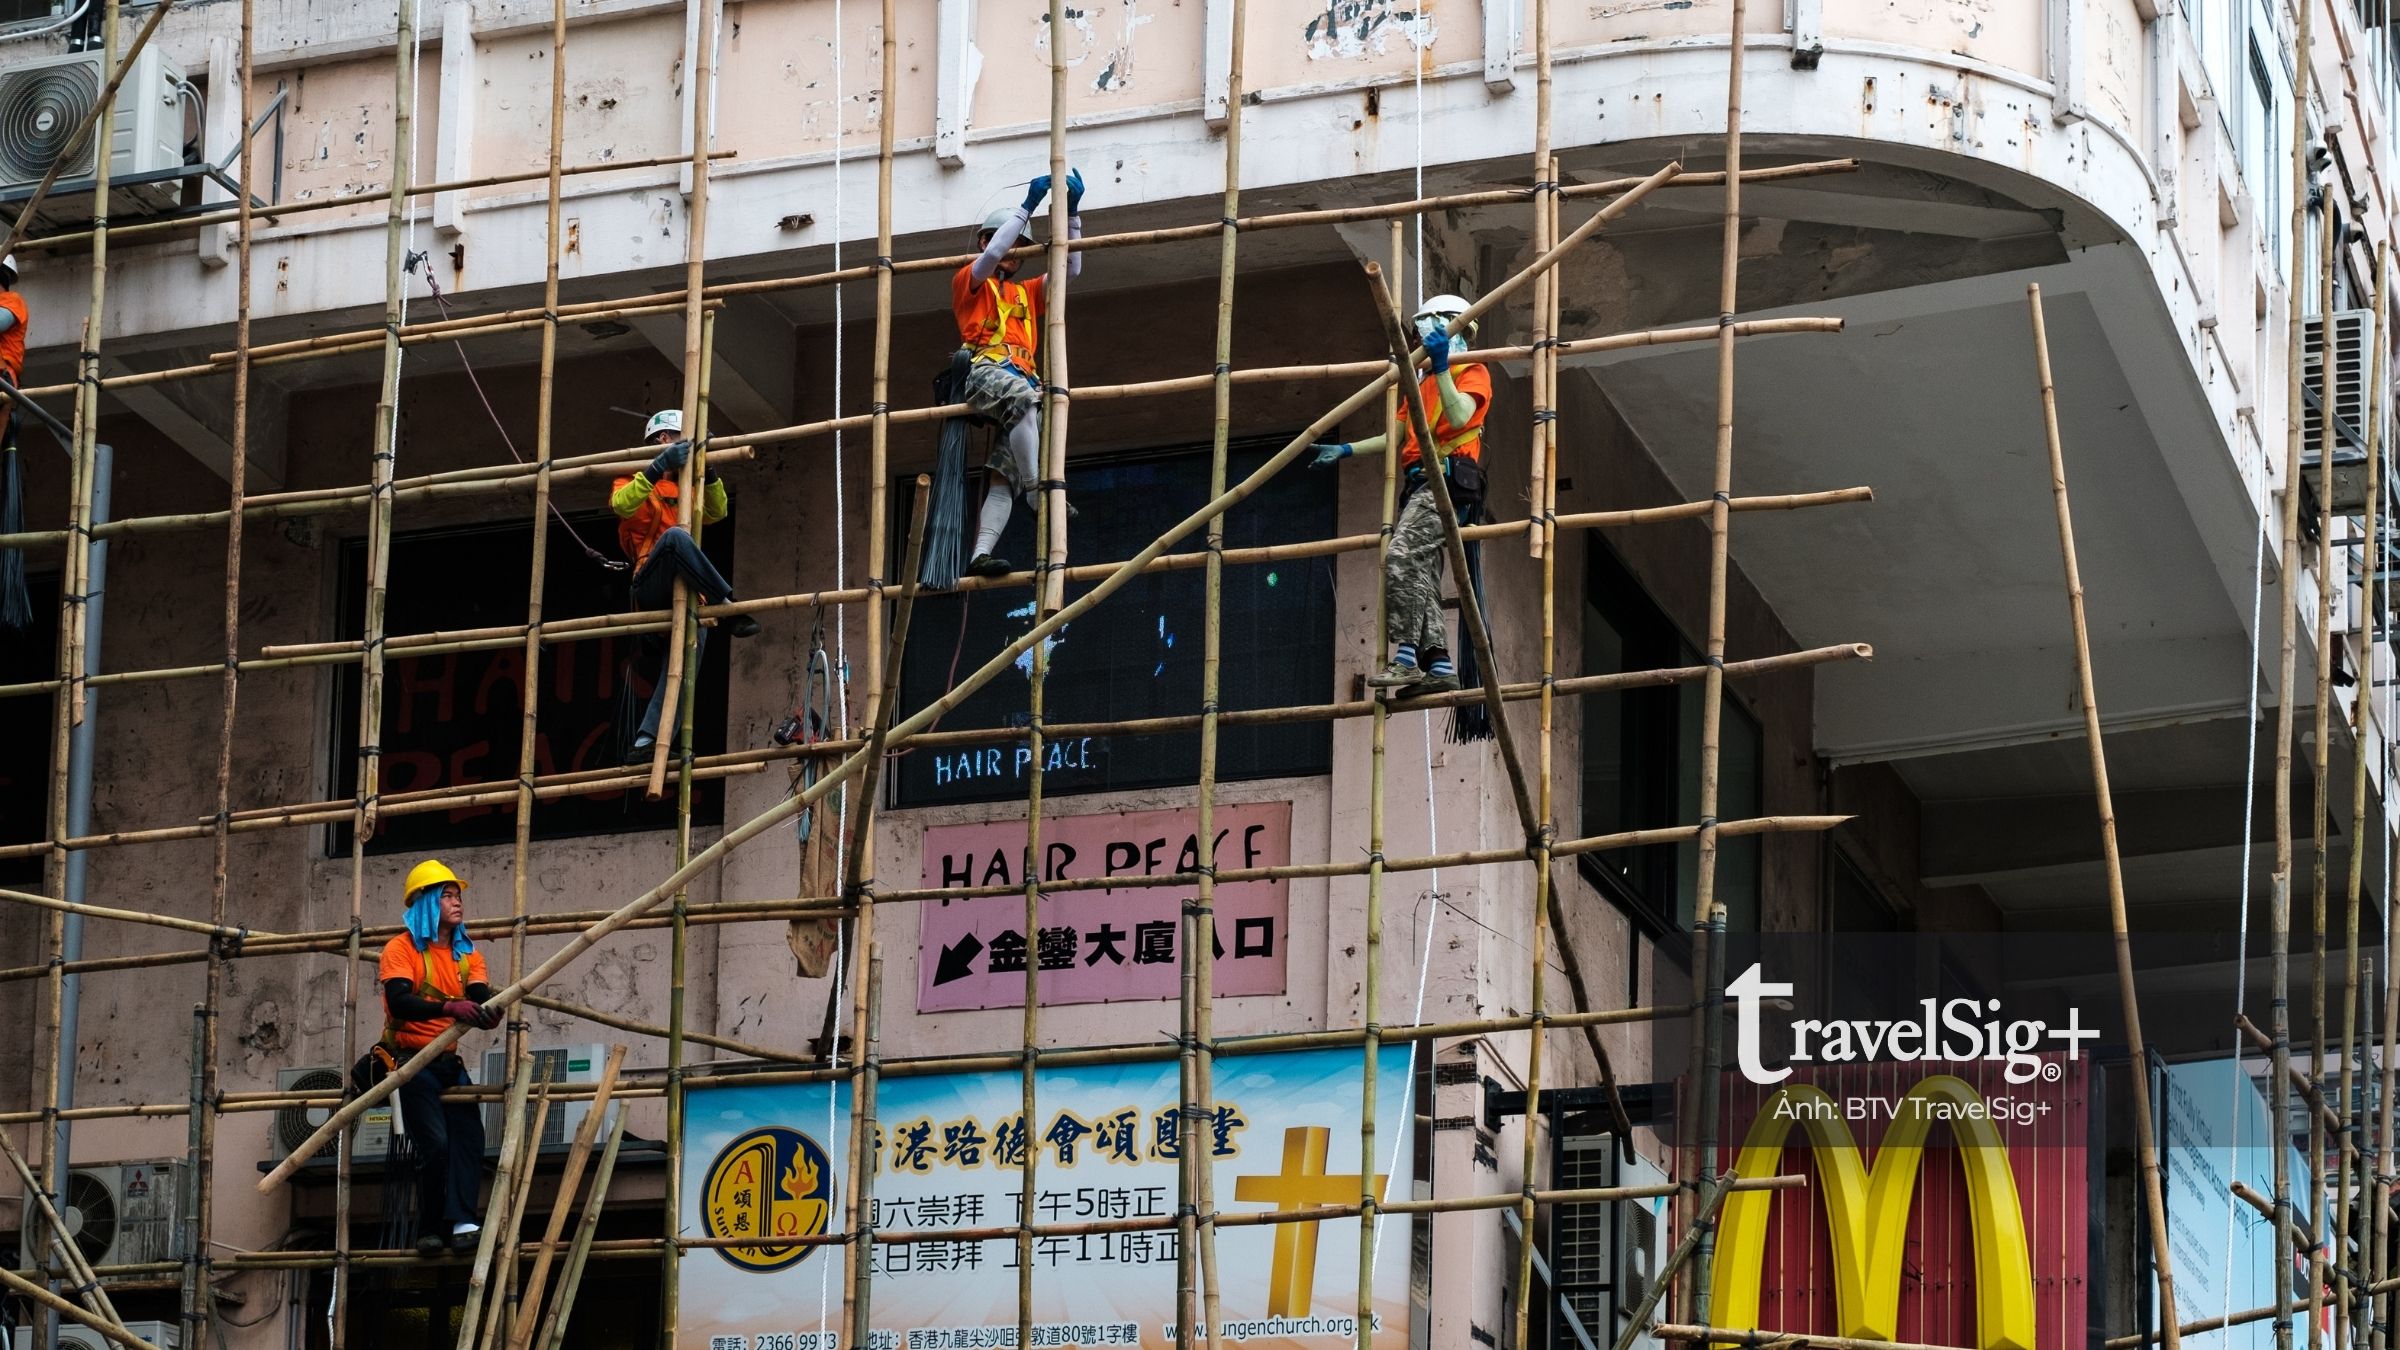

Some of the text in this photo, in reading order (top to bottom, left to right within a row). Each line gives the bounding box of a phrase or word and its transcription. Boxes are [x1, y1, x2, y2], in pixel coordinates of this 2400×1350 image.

[935, 737, 1097, 786] HAIR PACE.
[942, 843, 1077, 907] HAIR
[733, 1160, 755, 1185] A
[733, 1188, 753, 1232] 頌恩
[870, 1239, 984, 1273] 日崇拜
[757, 1335, 794, 1350] 2366
[908, 1323, 1138, 1350] 香港九龍尖沙咀敦道80號1字樓
[1165, 1315, 1379, 1340] ww.ungenchurch.org.k
